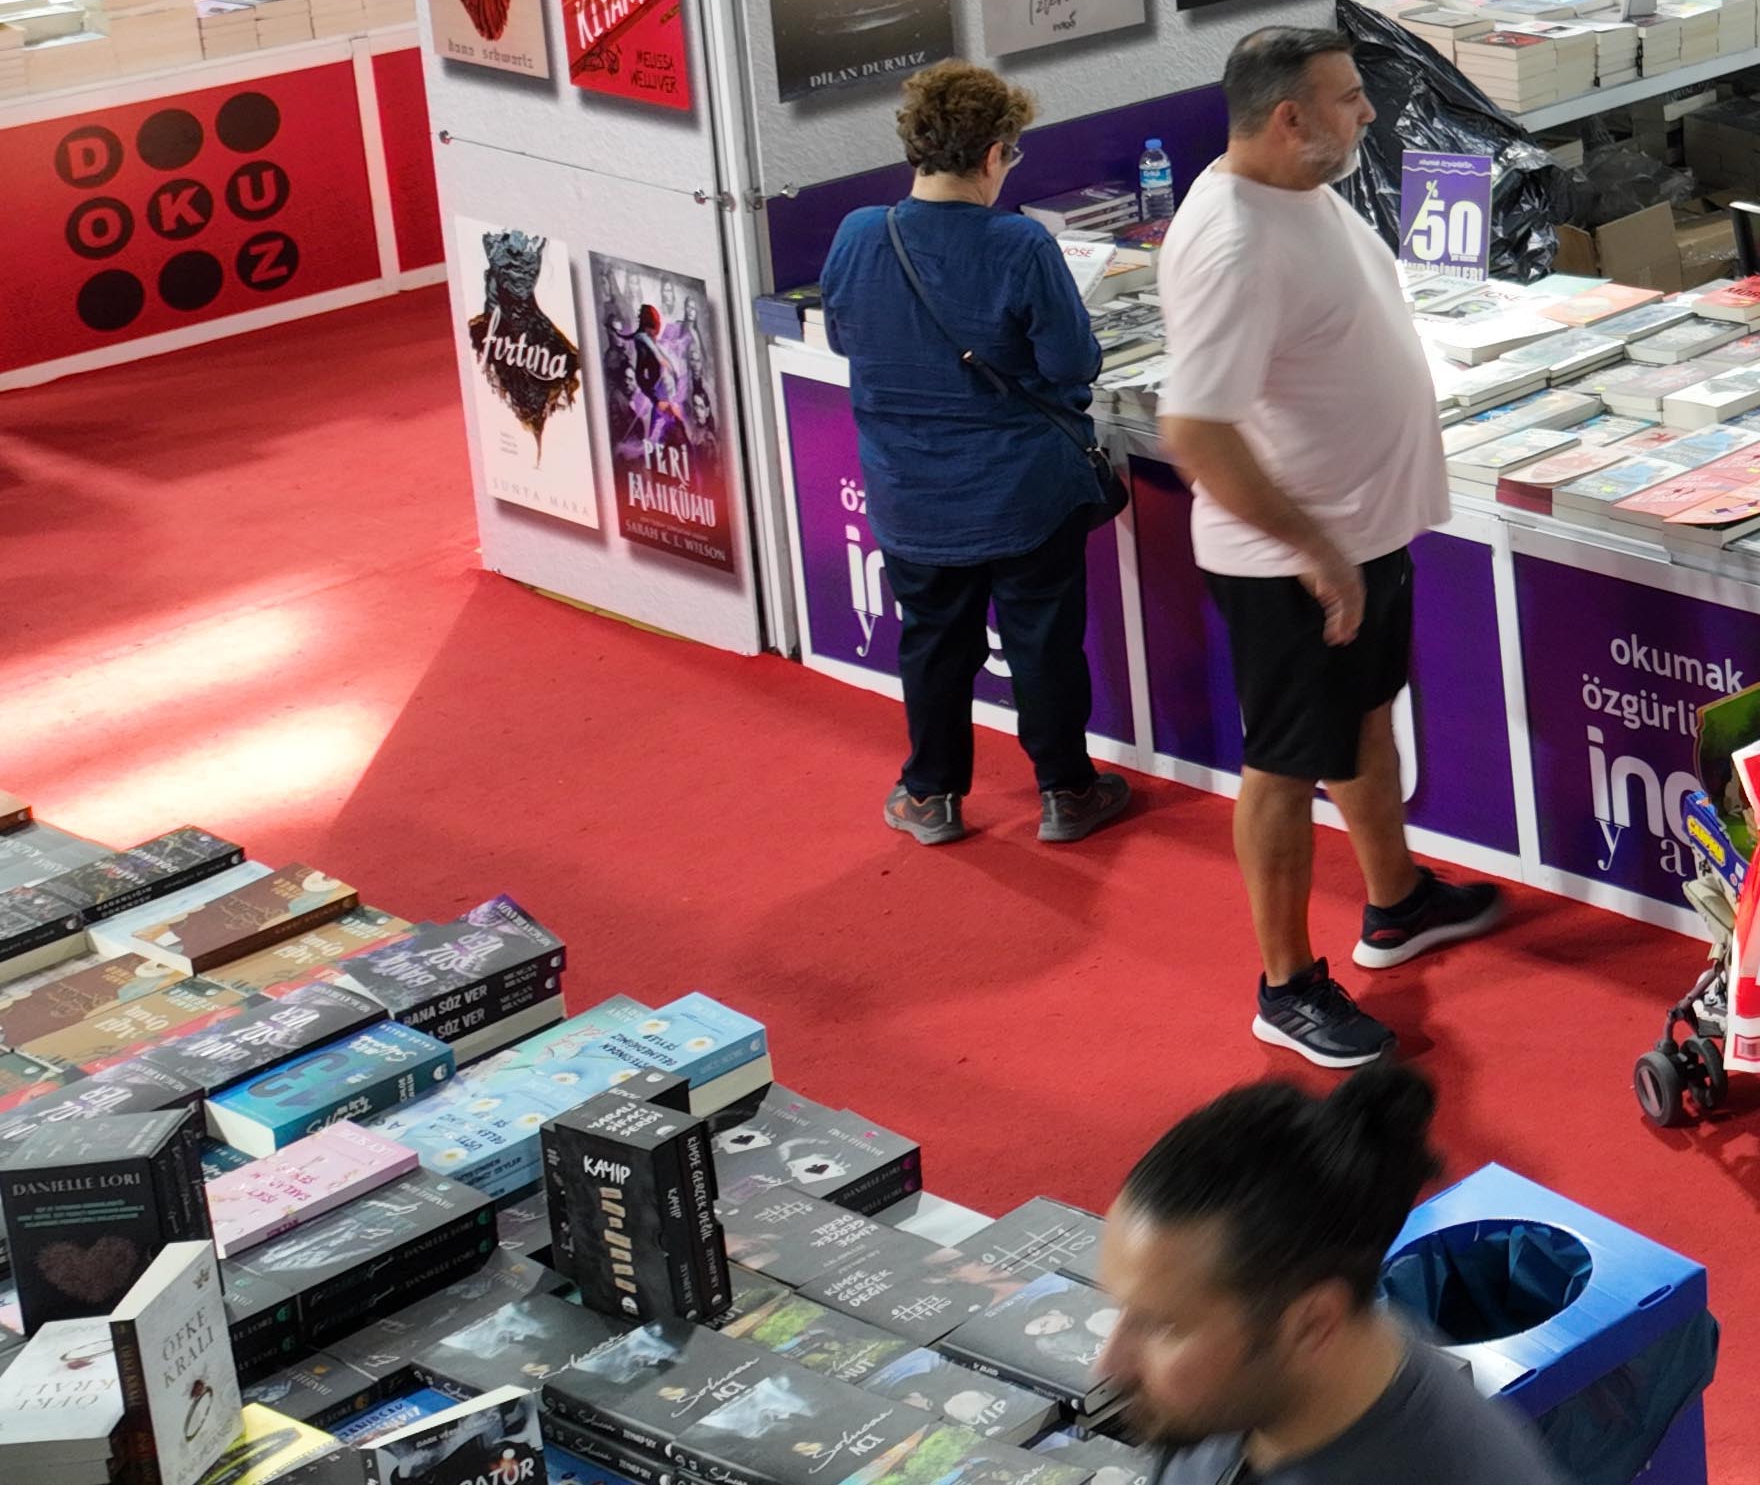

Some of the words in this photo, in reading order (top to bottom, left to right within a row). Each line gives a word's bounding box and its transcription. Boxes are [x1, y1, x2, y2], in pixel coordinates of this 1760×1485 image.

[863, 51, 926, 79] DURMAZ
[684, 534, 727, 563] WILSON
[1610, 633, 1746, 696] okumak
[438, 994, 461, 1016] SÖZ
[463, 984, 488, 1006] VER
[462, 1007, 486, 1029] VER
[12, 1176, 94, 1197] DANIELLE
[100, 1172, 142, 1188] LORI
[583, 1155, 631, 1185] KAYIP
[162, 1326, 216, 1389] KRALI
